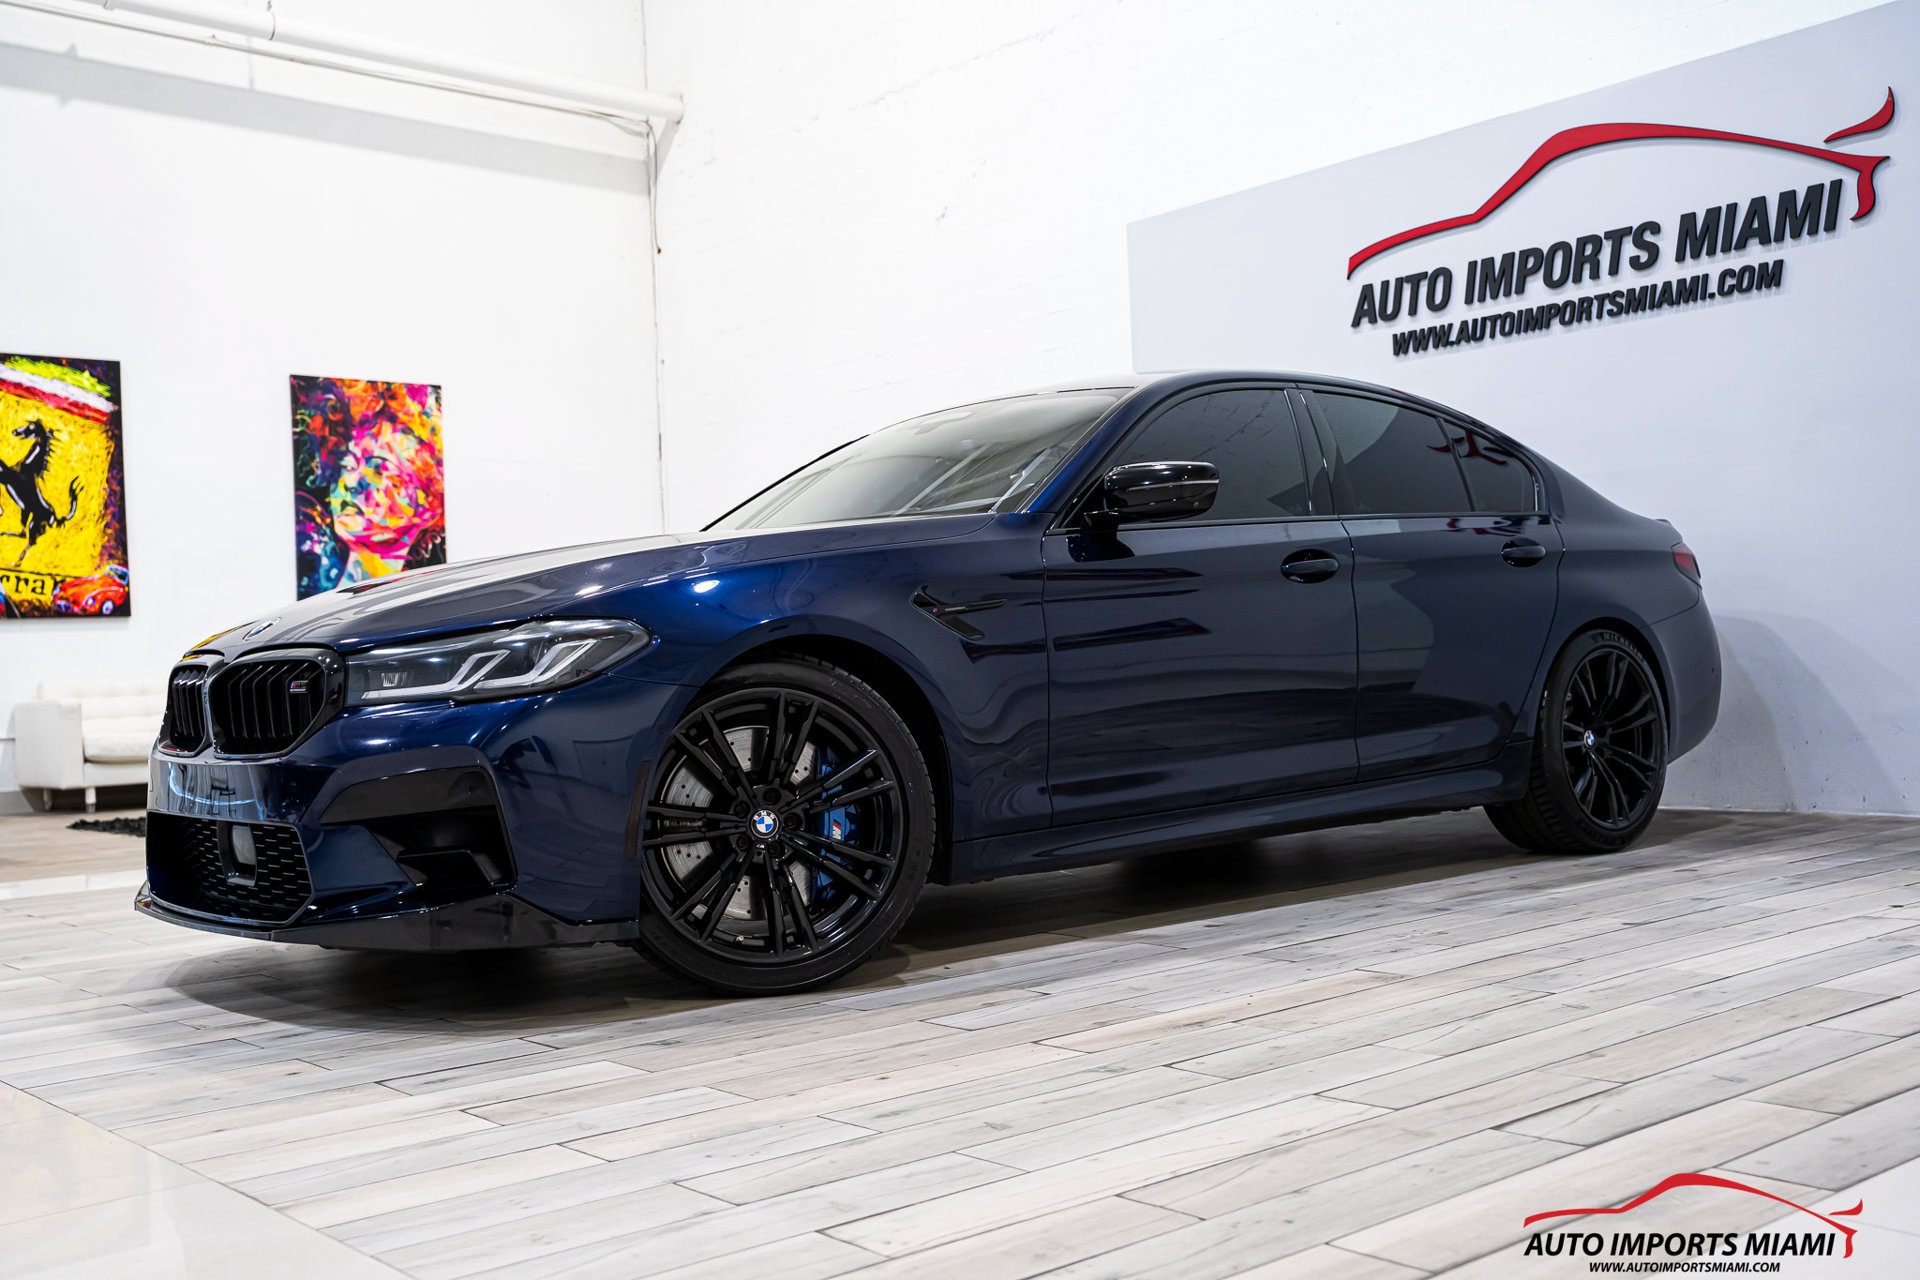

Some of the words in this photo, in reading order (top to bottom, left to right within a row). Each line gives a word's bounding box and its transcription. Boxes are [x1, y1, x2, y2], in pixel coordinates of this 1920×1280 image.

[1351, 266, 1453, 328] AUTO
[1464, 221, 1661, 305] IMPORTS
[1675, 178, 1842, 263] MIAMI
[1392, 259, 1784, 357] WWW.AUTOIMPORTSMIAMI.COM
